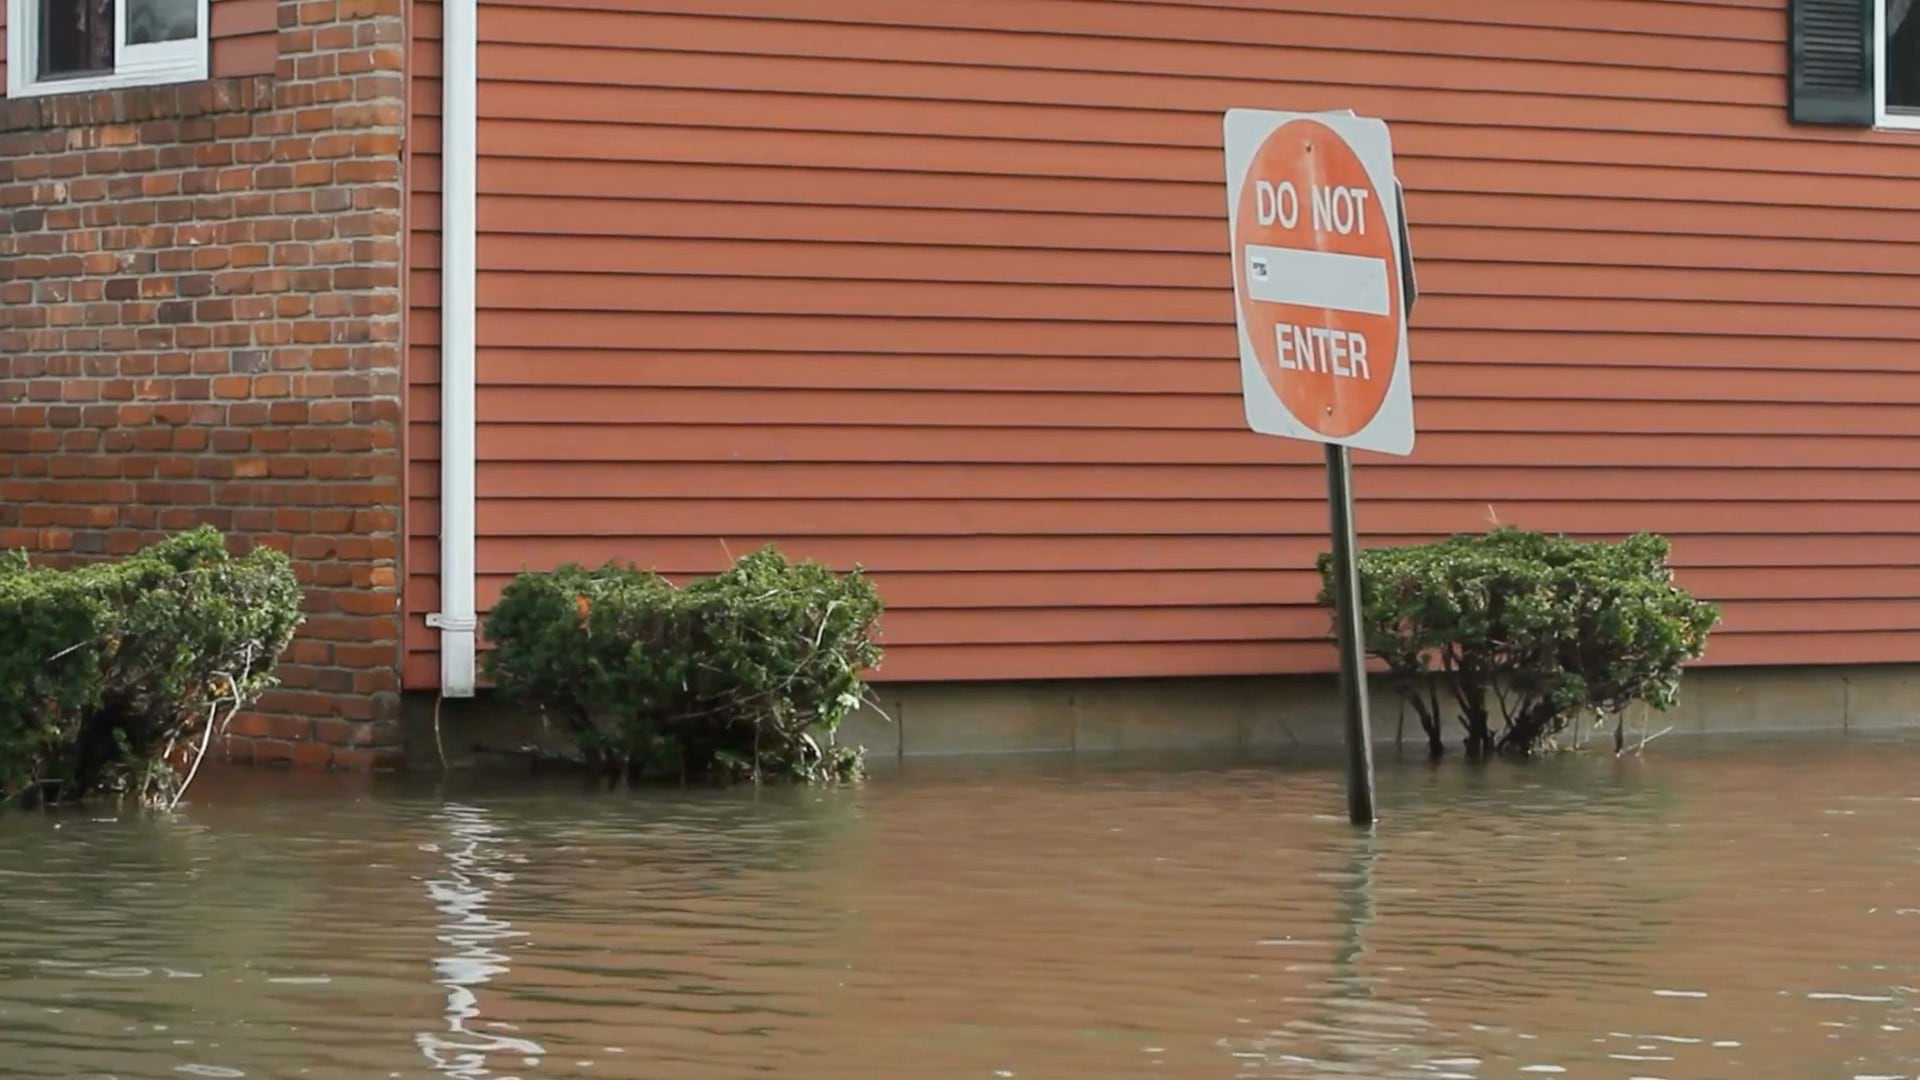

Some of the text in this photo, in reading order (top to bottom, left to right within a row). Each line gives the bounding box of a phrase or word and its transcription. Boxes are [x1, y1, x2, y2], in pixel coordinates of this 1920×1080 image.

[1256, 180, 1368, 235] DO NOT
[1274, 323, 1370, 379] ENTER
